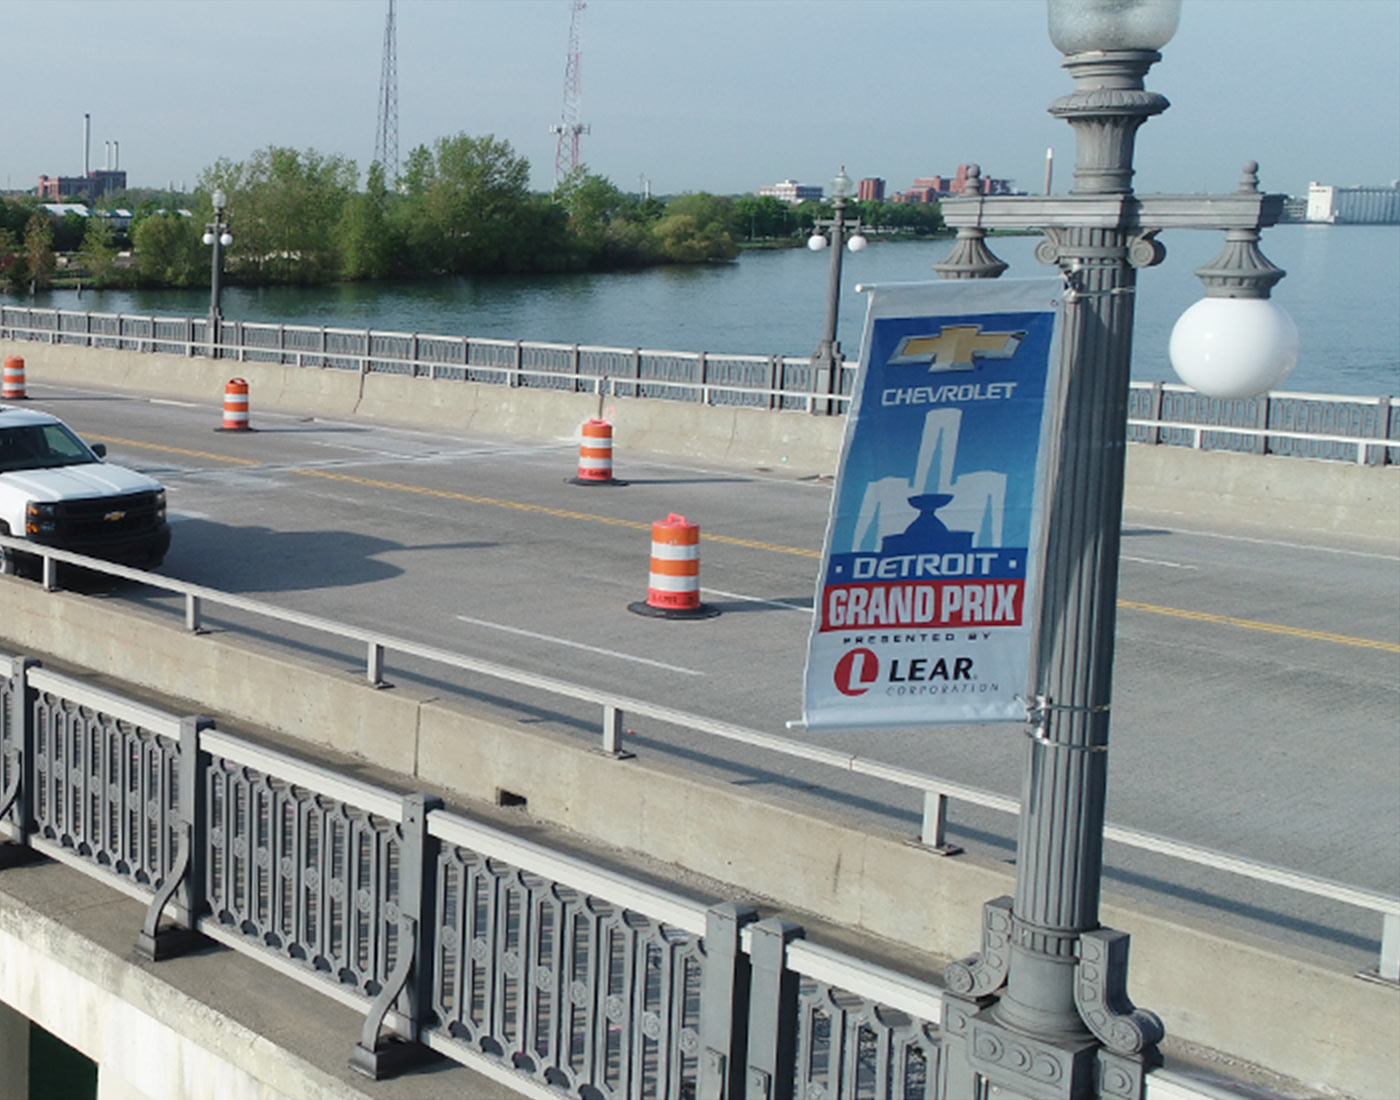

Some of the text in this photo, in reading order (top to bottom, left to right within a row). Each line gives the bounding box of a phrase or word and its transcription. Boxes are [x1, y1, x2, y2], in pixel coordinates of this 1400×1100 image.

[880, 381, 1017, 406] CHEVROLET
[852, 553, 999, 579] DETROIT
[828, 584, 1018, 627] GRAND PRIX
[843, 632, 992, 645] PRESENTED BY
[888, 657, 975, 682] LEAR
[885, 683, 1000, 697] CORPORATION
